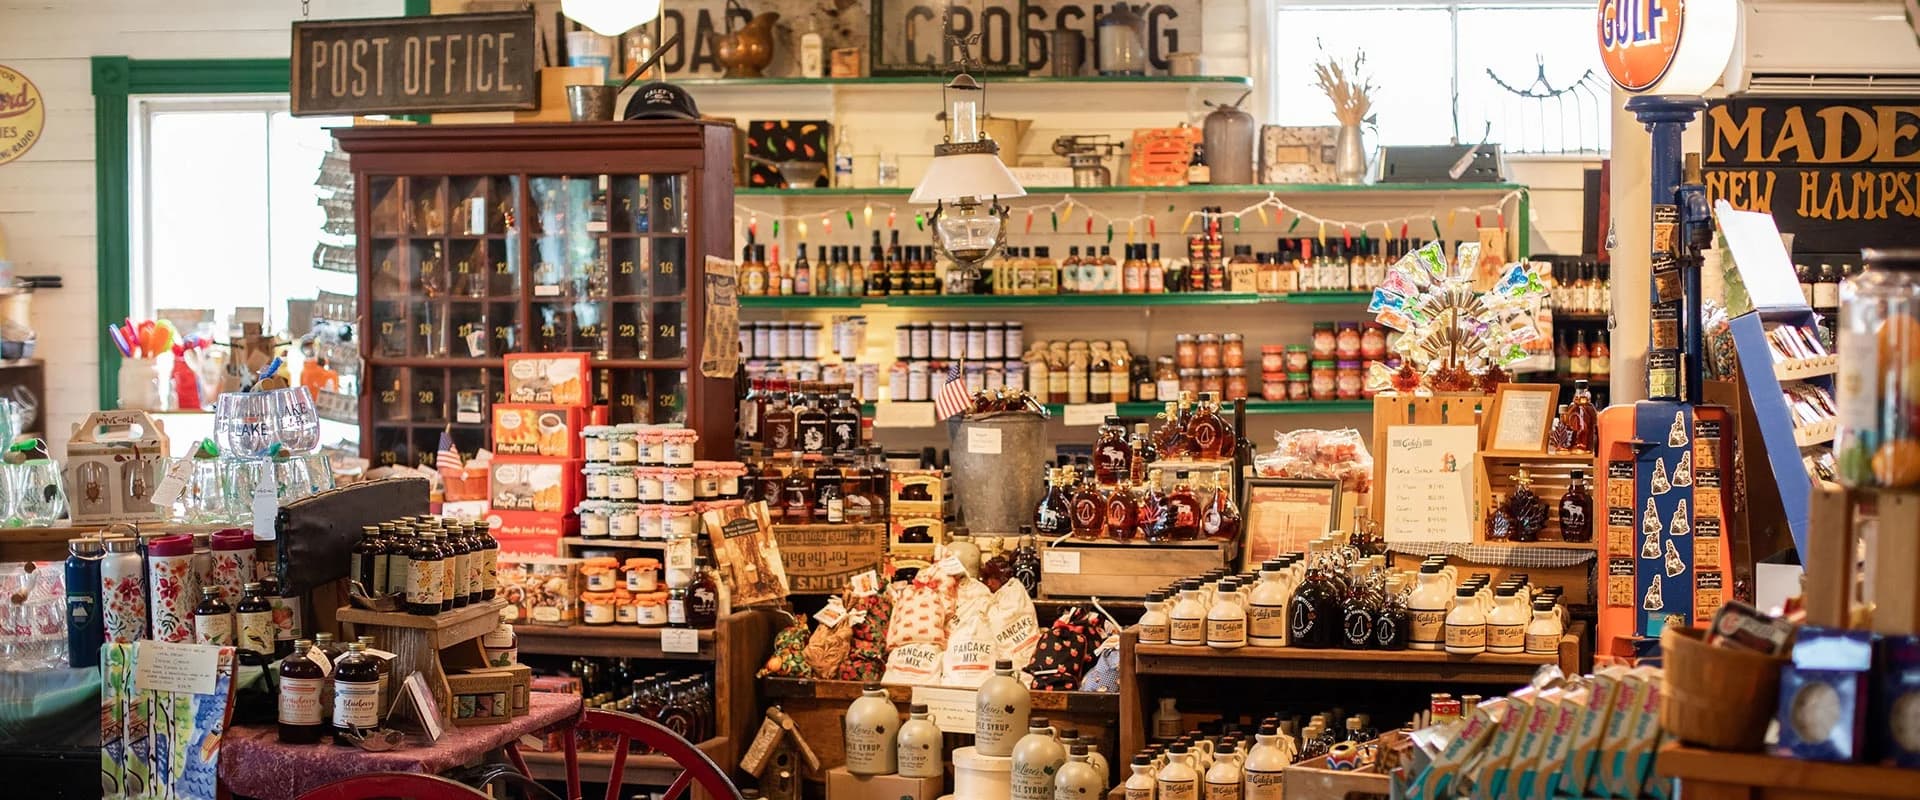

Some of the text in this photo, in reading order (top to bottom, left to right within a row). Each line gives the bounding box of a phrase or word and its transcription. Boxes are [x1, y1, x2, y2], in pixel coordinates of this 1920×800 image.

[1602, 0, 1665, 48] GULF
[905, 5, 1179, 70] CROSSIG
[311, 32, 523, 98] POST OFFICE.
[1707, 104, 1920, 163] MADE
[1705, 170, 1920, 220] NEW HAMPS
[622, 198, 631, 211] 7
[663, 197, 672, 210] 8
[421, 260, 433, 273] 10
[458, 261, 469, 273] 11
[620, 260, 633, 274] 15
[660, 261, 673, 274] 16
[541, 325, 555, 337] 21
[581, 325, 597, 337] 22
[620, 324, 635, 337] 23
[660, 324, 675, 337] 24
[381, 390, 396, 403] 25
[621, 394, 635, 407] 31
[661, 394, 675, 407] 32
[236, 422, 268, 436] LAKE
[779, 551, 848, 567] For the Bab
[996, 617, 1034, 643] PANCAKE
[1012, 632, 1029, 645] MIX
[953, 641, 991, 655] PANCAKE
[897, 647, 936, 663] PANCAKE
[962, 653, 979, 663] MIX
[904, 656, 921, 668] MIX
[343, 698, 376, 711] Blueberry
